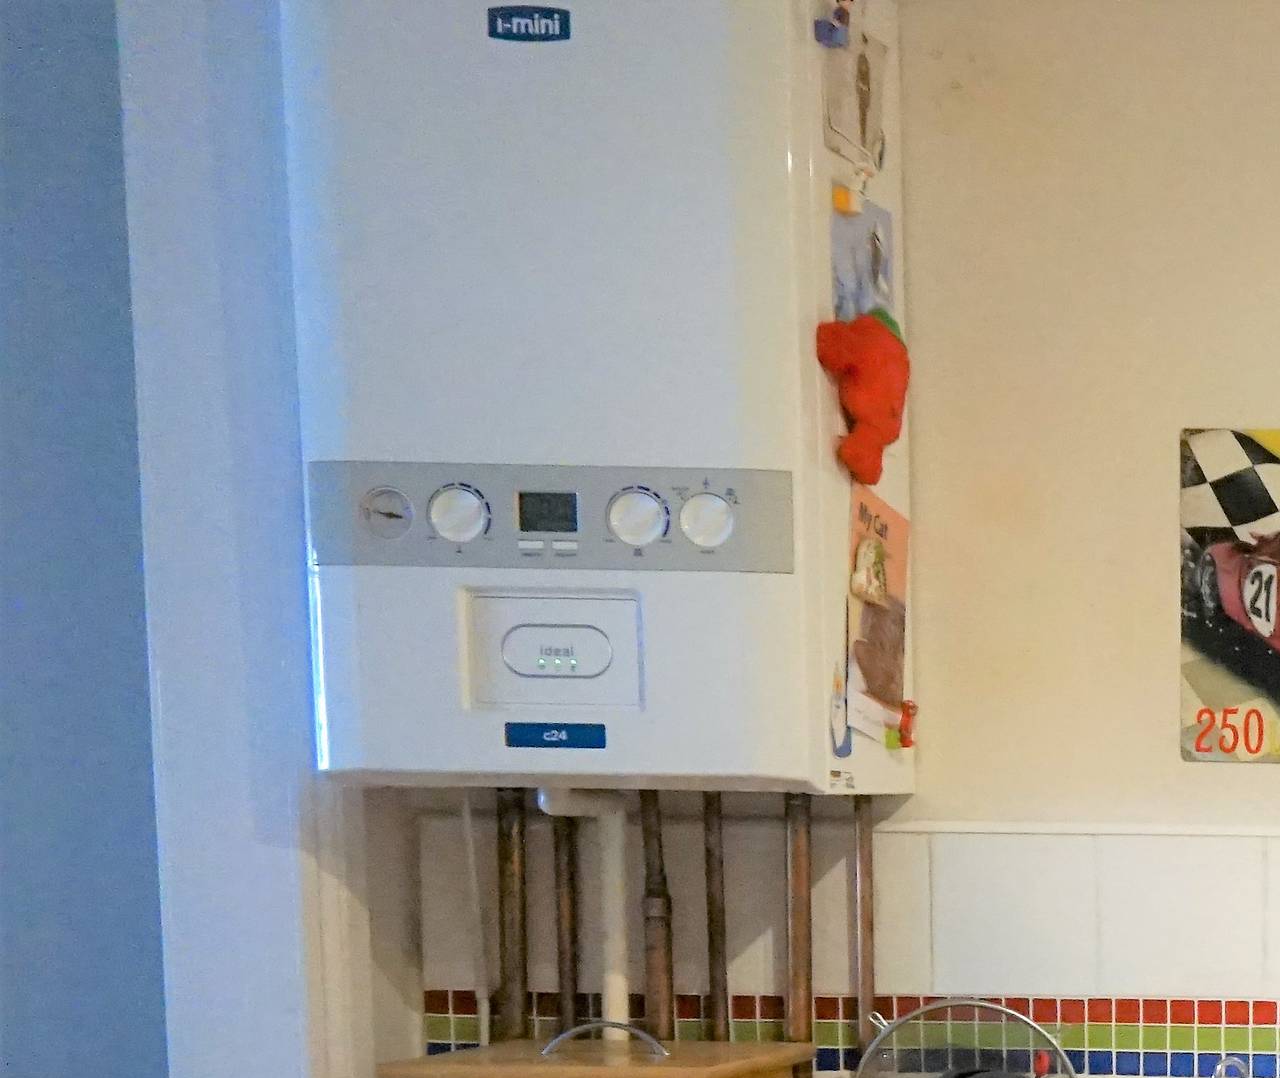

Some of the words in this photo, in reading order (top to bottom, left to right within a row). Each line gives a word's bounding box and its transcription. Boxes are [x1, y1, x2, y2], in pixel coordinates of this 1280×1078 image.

[497, 13, 560, 35] i-mini
[1250, 570, 1274, 622] 21
[1194, 707, 1265, 754] 250
